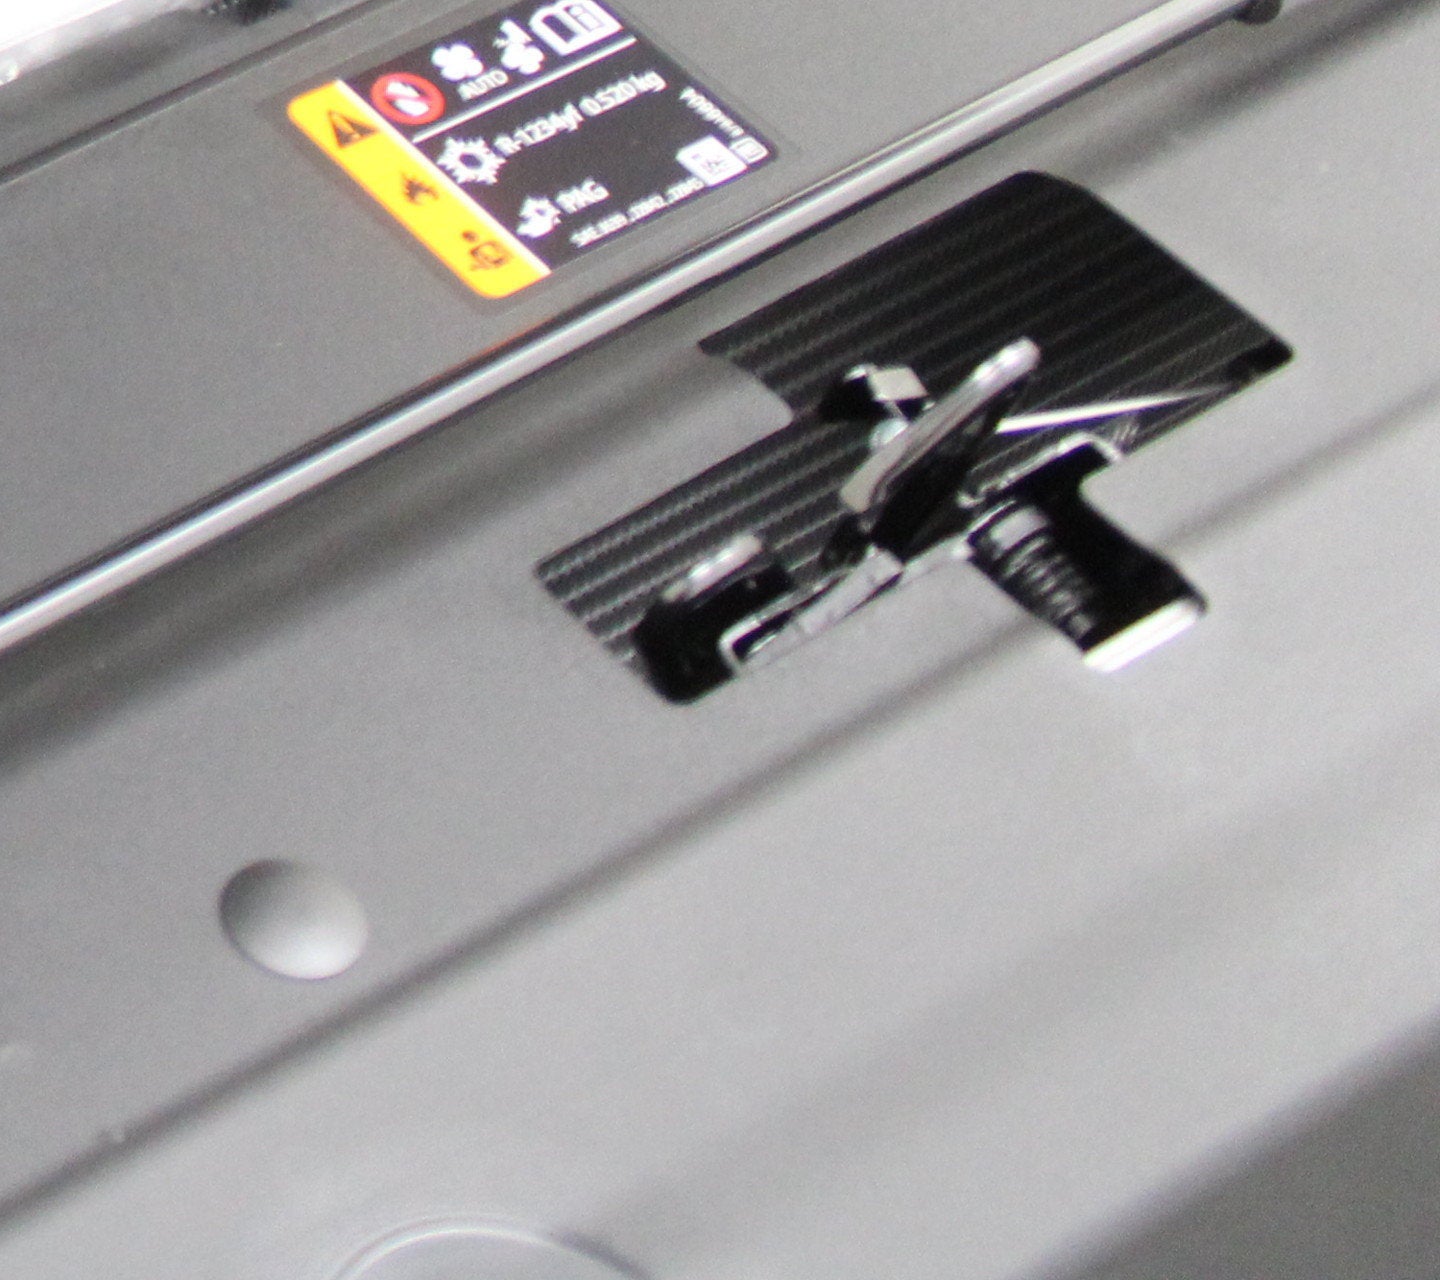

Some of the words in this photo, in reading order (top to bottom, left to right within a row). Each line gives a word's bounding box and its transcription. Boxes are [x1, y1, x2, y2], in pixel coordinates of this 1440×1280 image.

[457, 69, 509, 101] AUTO
[494, 102, 585, 156] R-1234yf
[631, 69, 668, 95] kg
[556, 177, 610, 216] PAG
